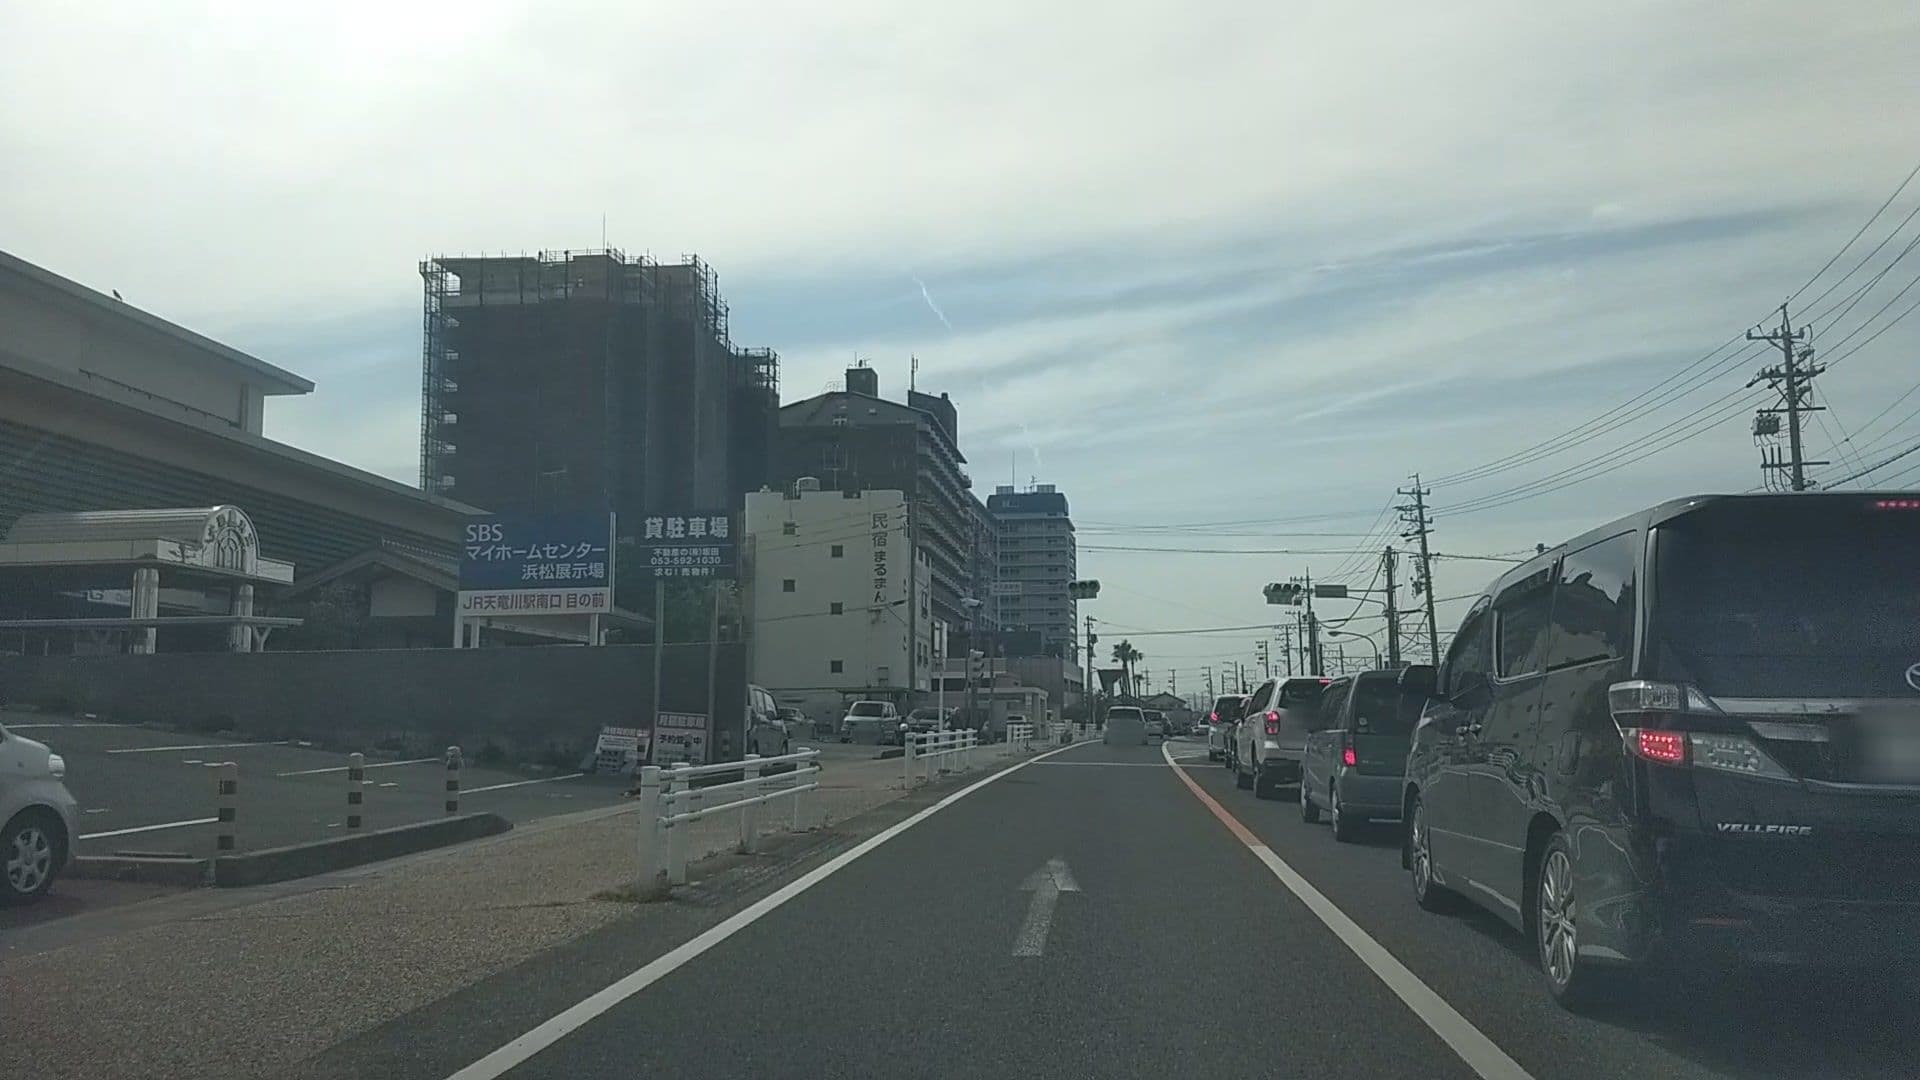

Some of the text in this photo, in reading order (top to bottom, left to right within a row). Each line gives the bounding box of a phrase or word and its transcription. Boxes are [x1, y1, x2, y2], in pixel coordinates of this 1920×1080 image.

[466, 523, 504, 543] SBS
[645, 516, 728, 539] 貸駐車場
[465, 542, 606, 561] マイホームセンター
[650, 556, 721, 566] 053-592-1030
[521, 562, 605, 580] 浜松展示場
[463, 592, 605, 610] JR天竜川駅南口 目の前
[1716, 822, 1813, 836] VELLFIRE
